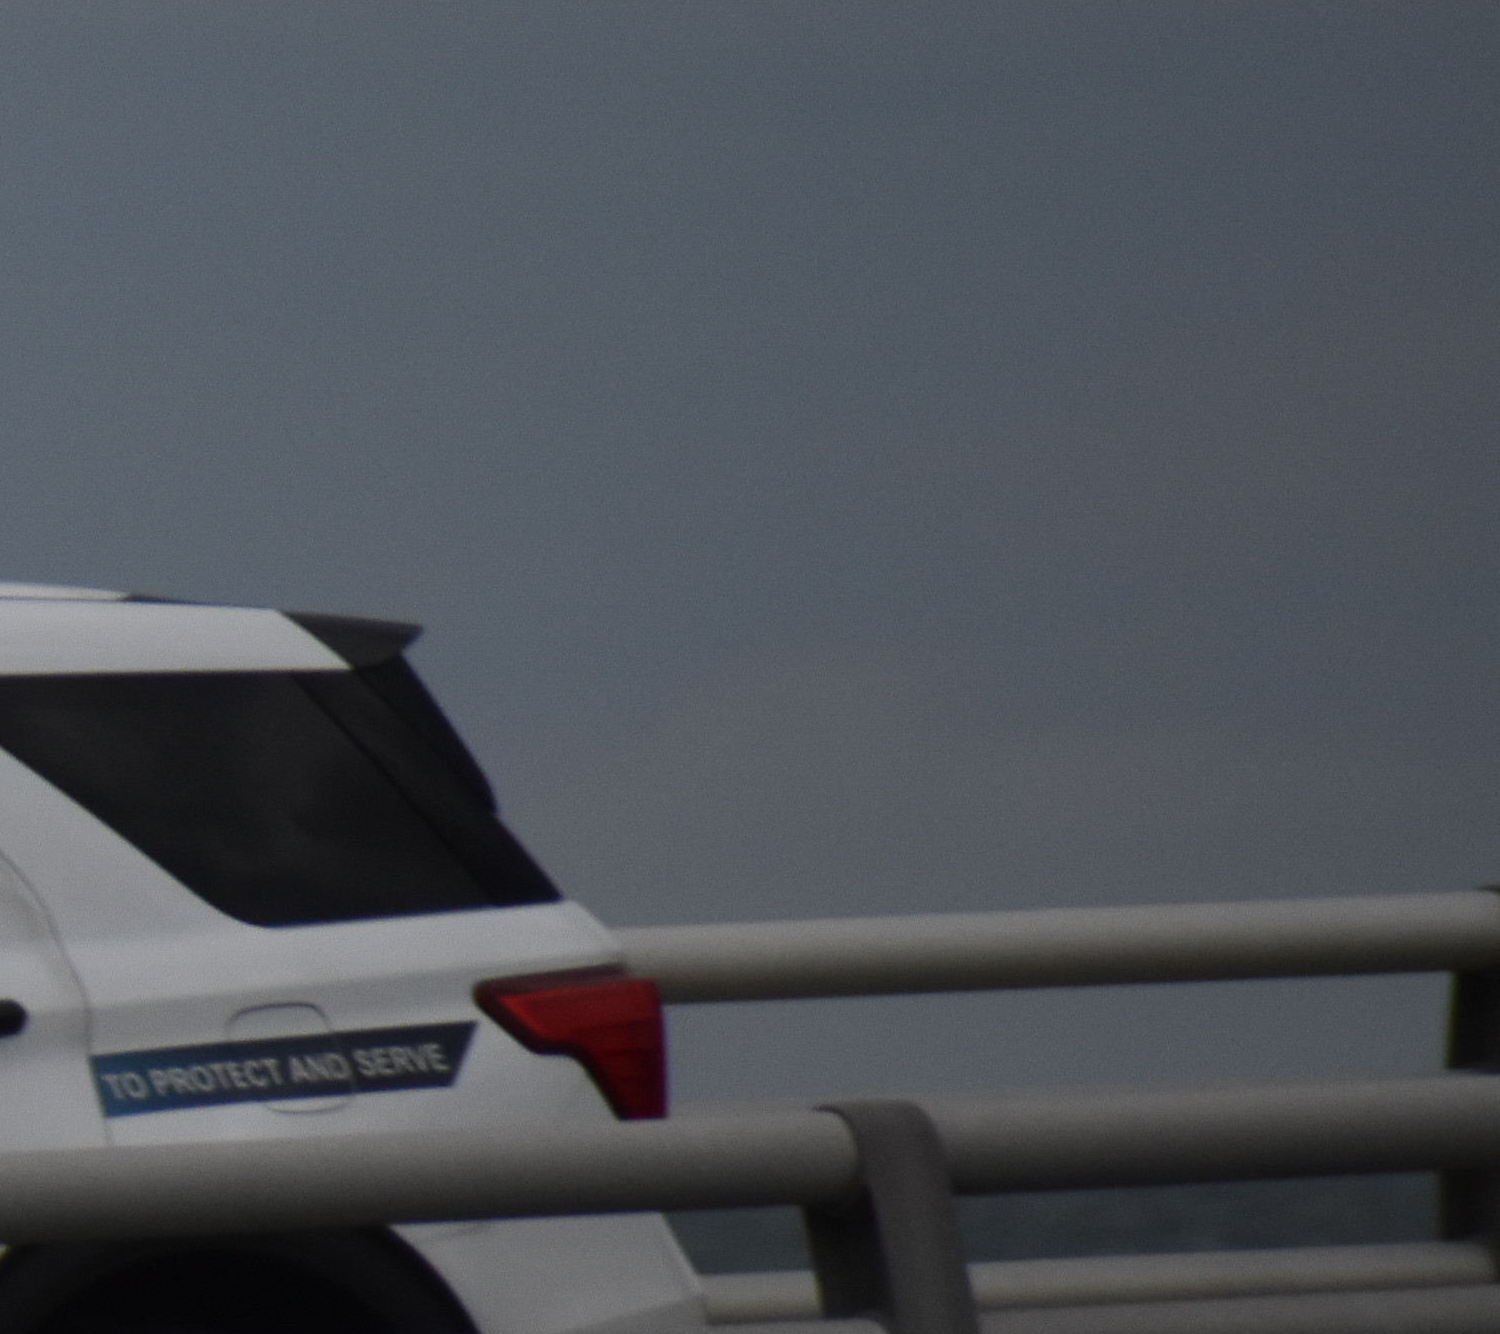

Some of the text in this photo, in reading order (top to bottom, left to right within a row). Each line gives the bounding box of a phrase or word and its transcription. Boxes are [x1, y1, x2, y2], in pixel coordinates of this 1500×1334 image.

[102, 1041, 448, 1099] TO PROTECT AND SERVE
